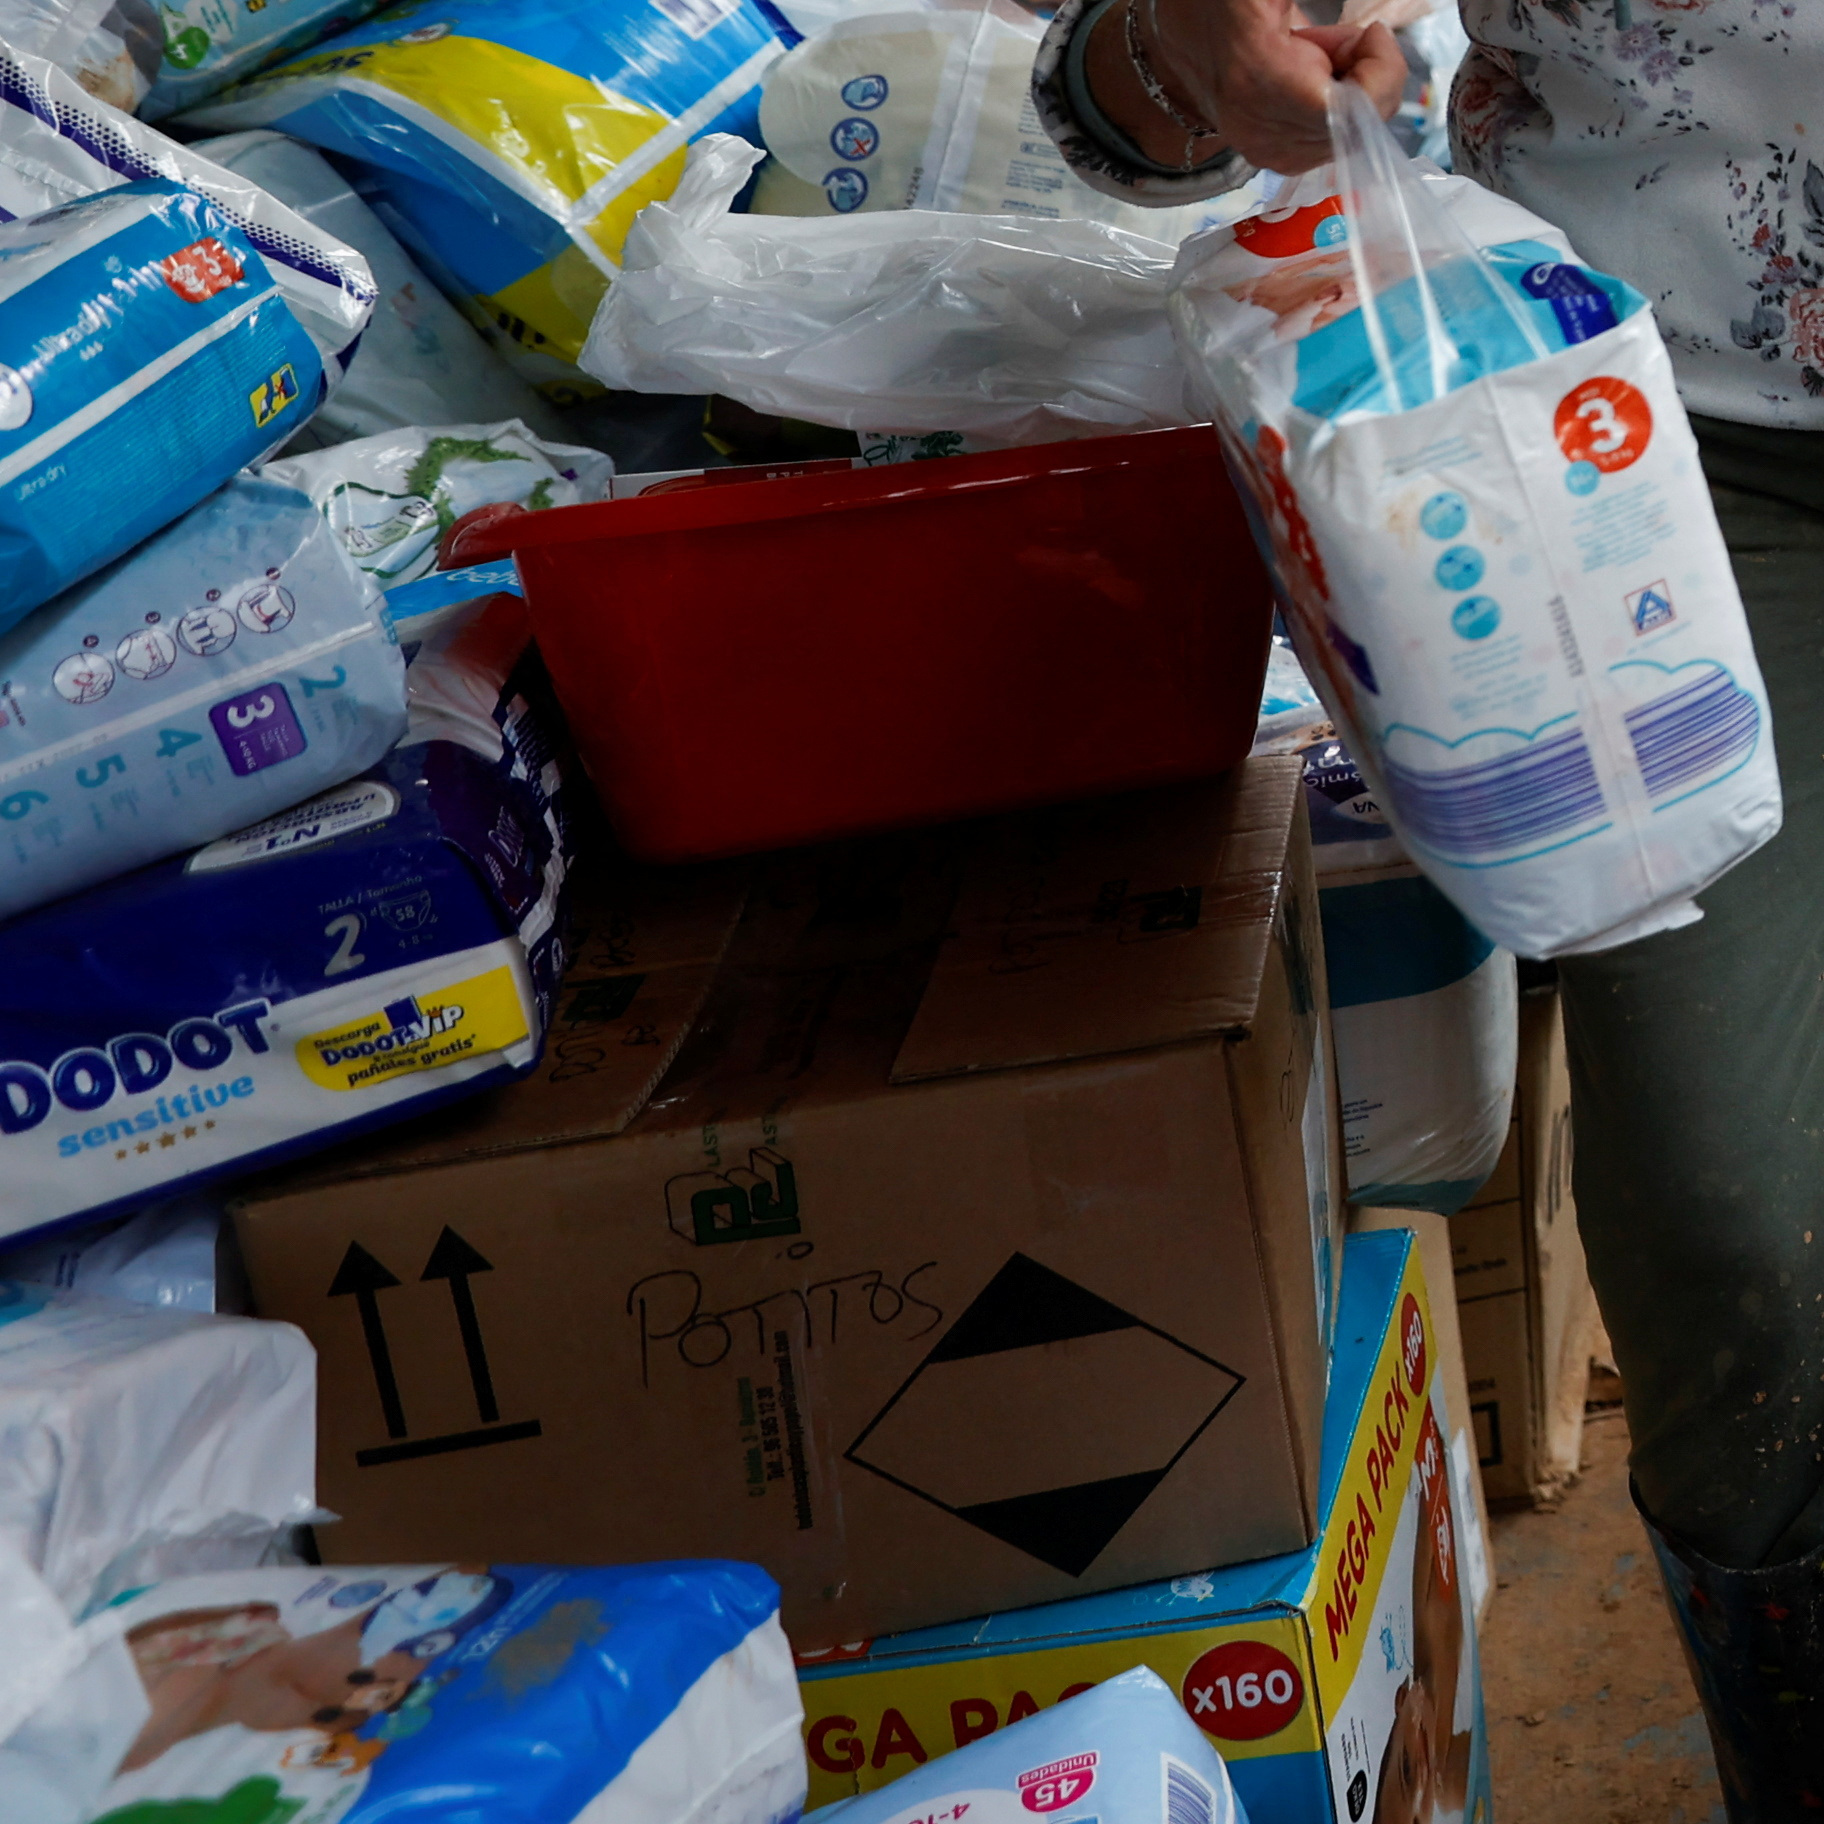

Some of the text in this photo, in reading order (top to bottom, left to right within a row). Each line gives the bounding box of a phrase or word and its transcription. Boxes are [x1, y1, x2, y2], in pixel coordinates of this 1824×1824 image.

[1576, 398, 1629, 455] 3
[226, 694, 275, 729] 3
[156, 727, 202, 758] 4
[75, 753, 127, 790] 5
[0, 789, 50, 821] 6
[394, 902, 416, 923] 58
[323, 911, 366, 977] 2
[313, 1021, 381, 1050] Descarga
[320, 1025, 410, 1067] DODOT
[0, 996, 269, 1136] DODOT
[347, 1051, 416, 1089] pañales
[57, 1075, 255, 1159] sensitive
[1404, 1306, 1423, 1384] x160
[1325, 1518, 1375, 1662] MEGA
[1365, 1360, 1409, 1507] PACK
[1191, 1669, 1295, 1717] x160
[1018, 1752, 1098, 1787] Unidades
[1036, 1772, 1084, 1809] 45
